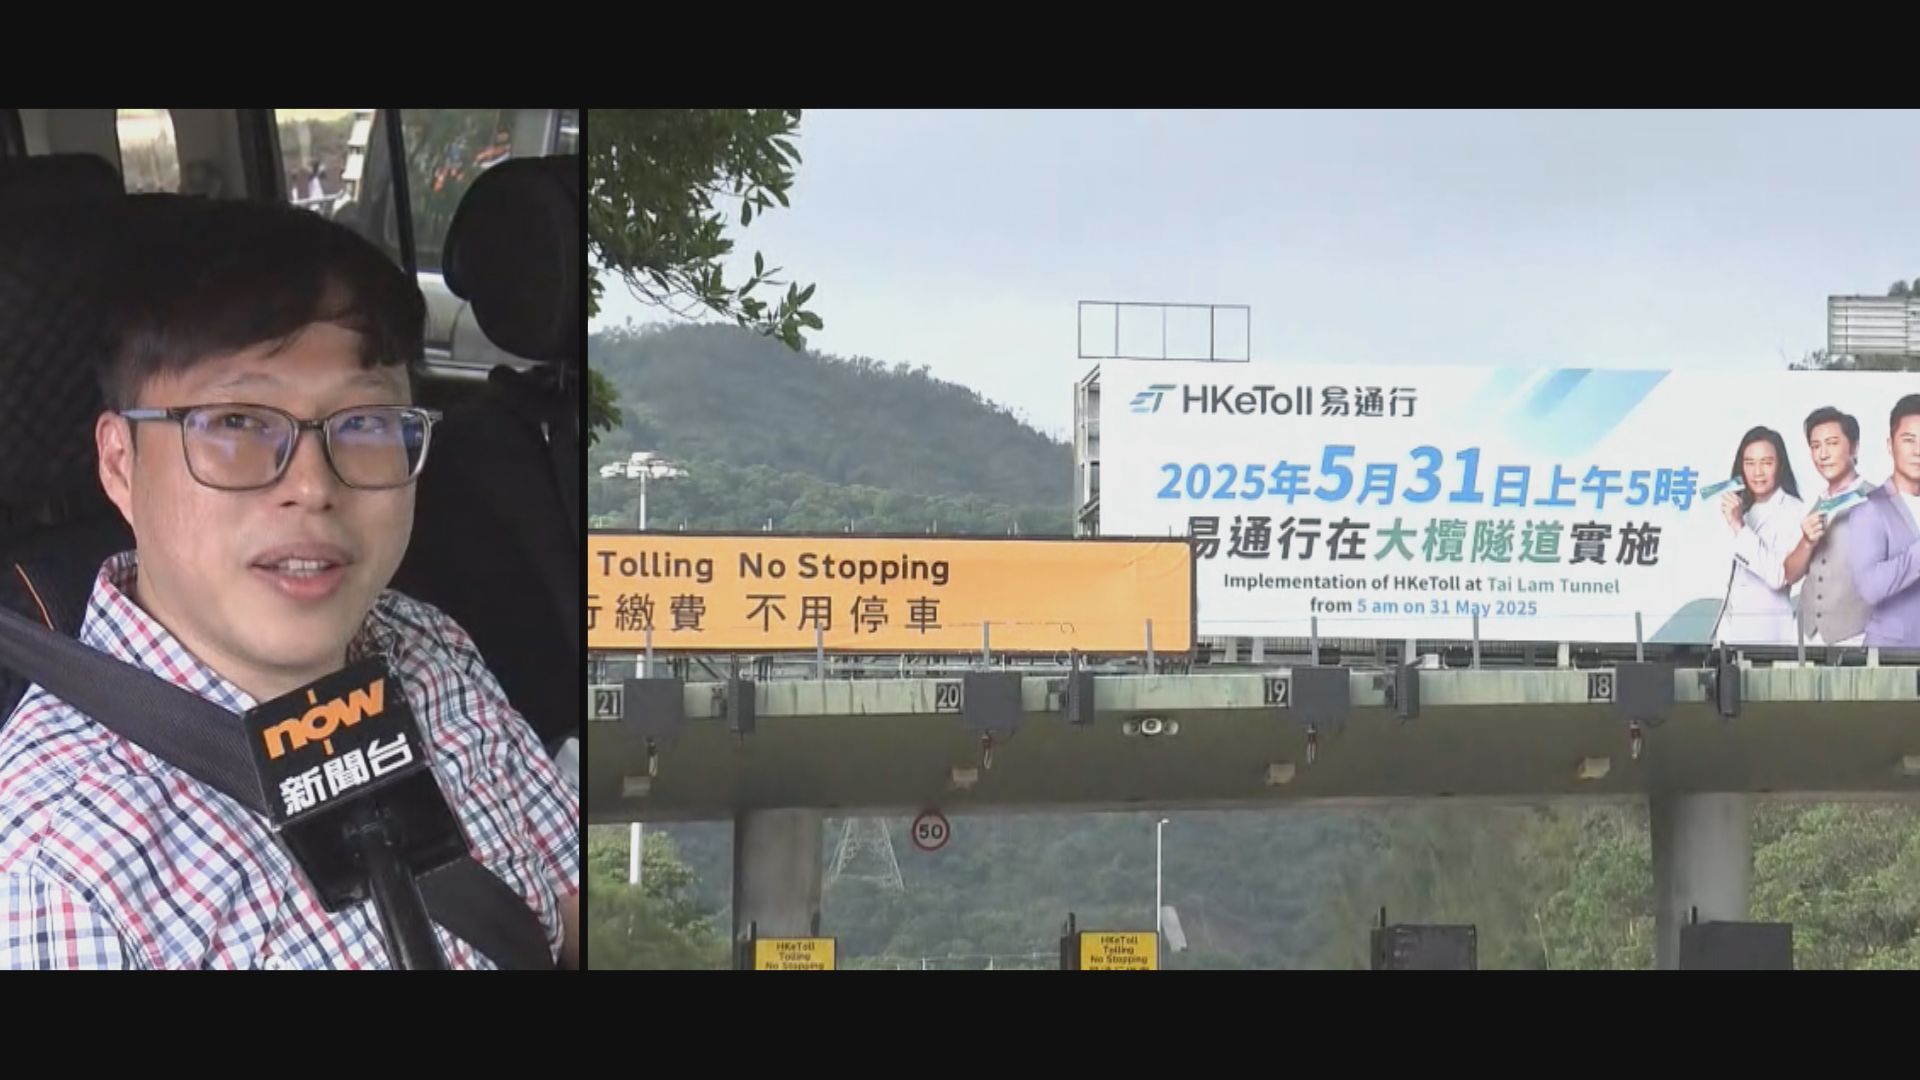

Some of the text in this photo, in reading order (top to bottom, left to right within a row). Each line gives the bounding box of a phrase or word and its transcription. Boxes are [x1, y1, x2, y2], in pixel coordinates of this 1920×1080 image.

[1182, 384, 1313, 415] HKeToll
[1320, 386, 1418, 417] 易通行
[1155, 443, 1700, 511] 2025年5月31日上午5時
[1188, 515, 1662, 567] 易通行在大欖隧道實施
[597, 551, 951, 585] Tolling No Stopping
[1224, 573, 1620, 594] Implementation of HKeToll at Tai Lam Tunnel
[745, 594, 943, 634] 不用停車
[1310, 597, 1538, 617] from 5 am on 31 May 2025
[938, 685, 960, 708] 20
[1267, 679, 1286, 702] 19
[1590, 675, 1611, 698] 18
[597, 691, 618, 714] 21
[263, 678, 385, 760] now
[279, 732, 414, 817] 新聞台
[918, 823, 943, 840] 50
